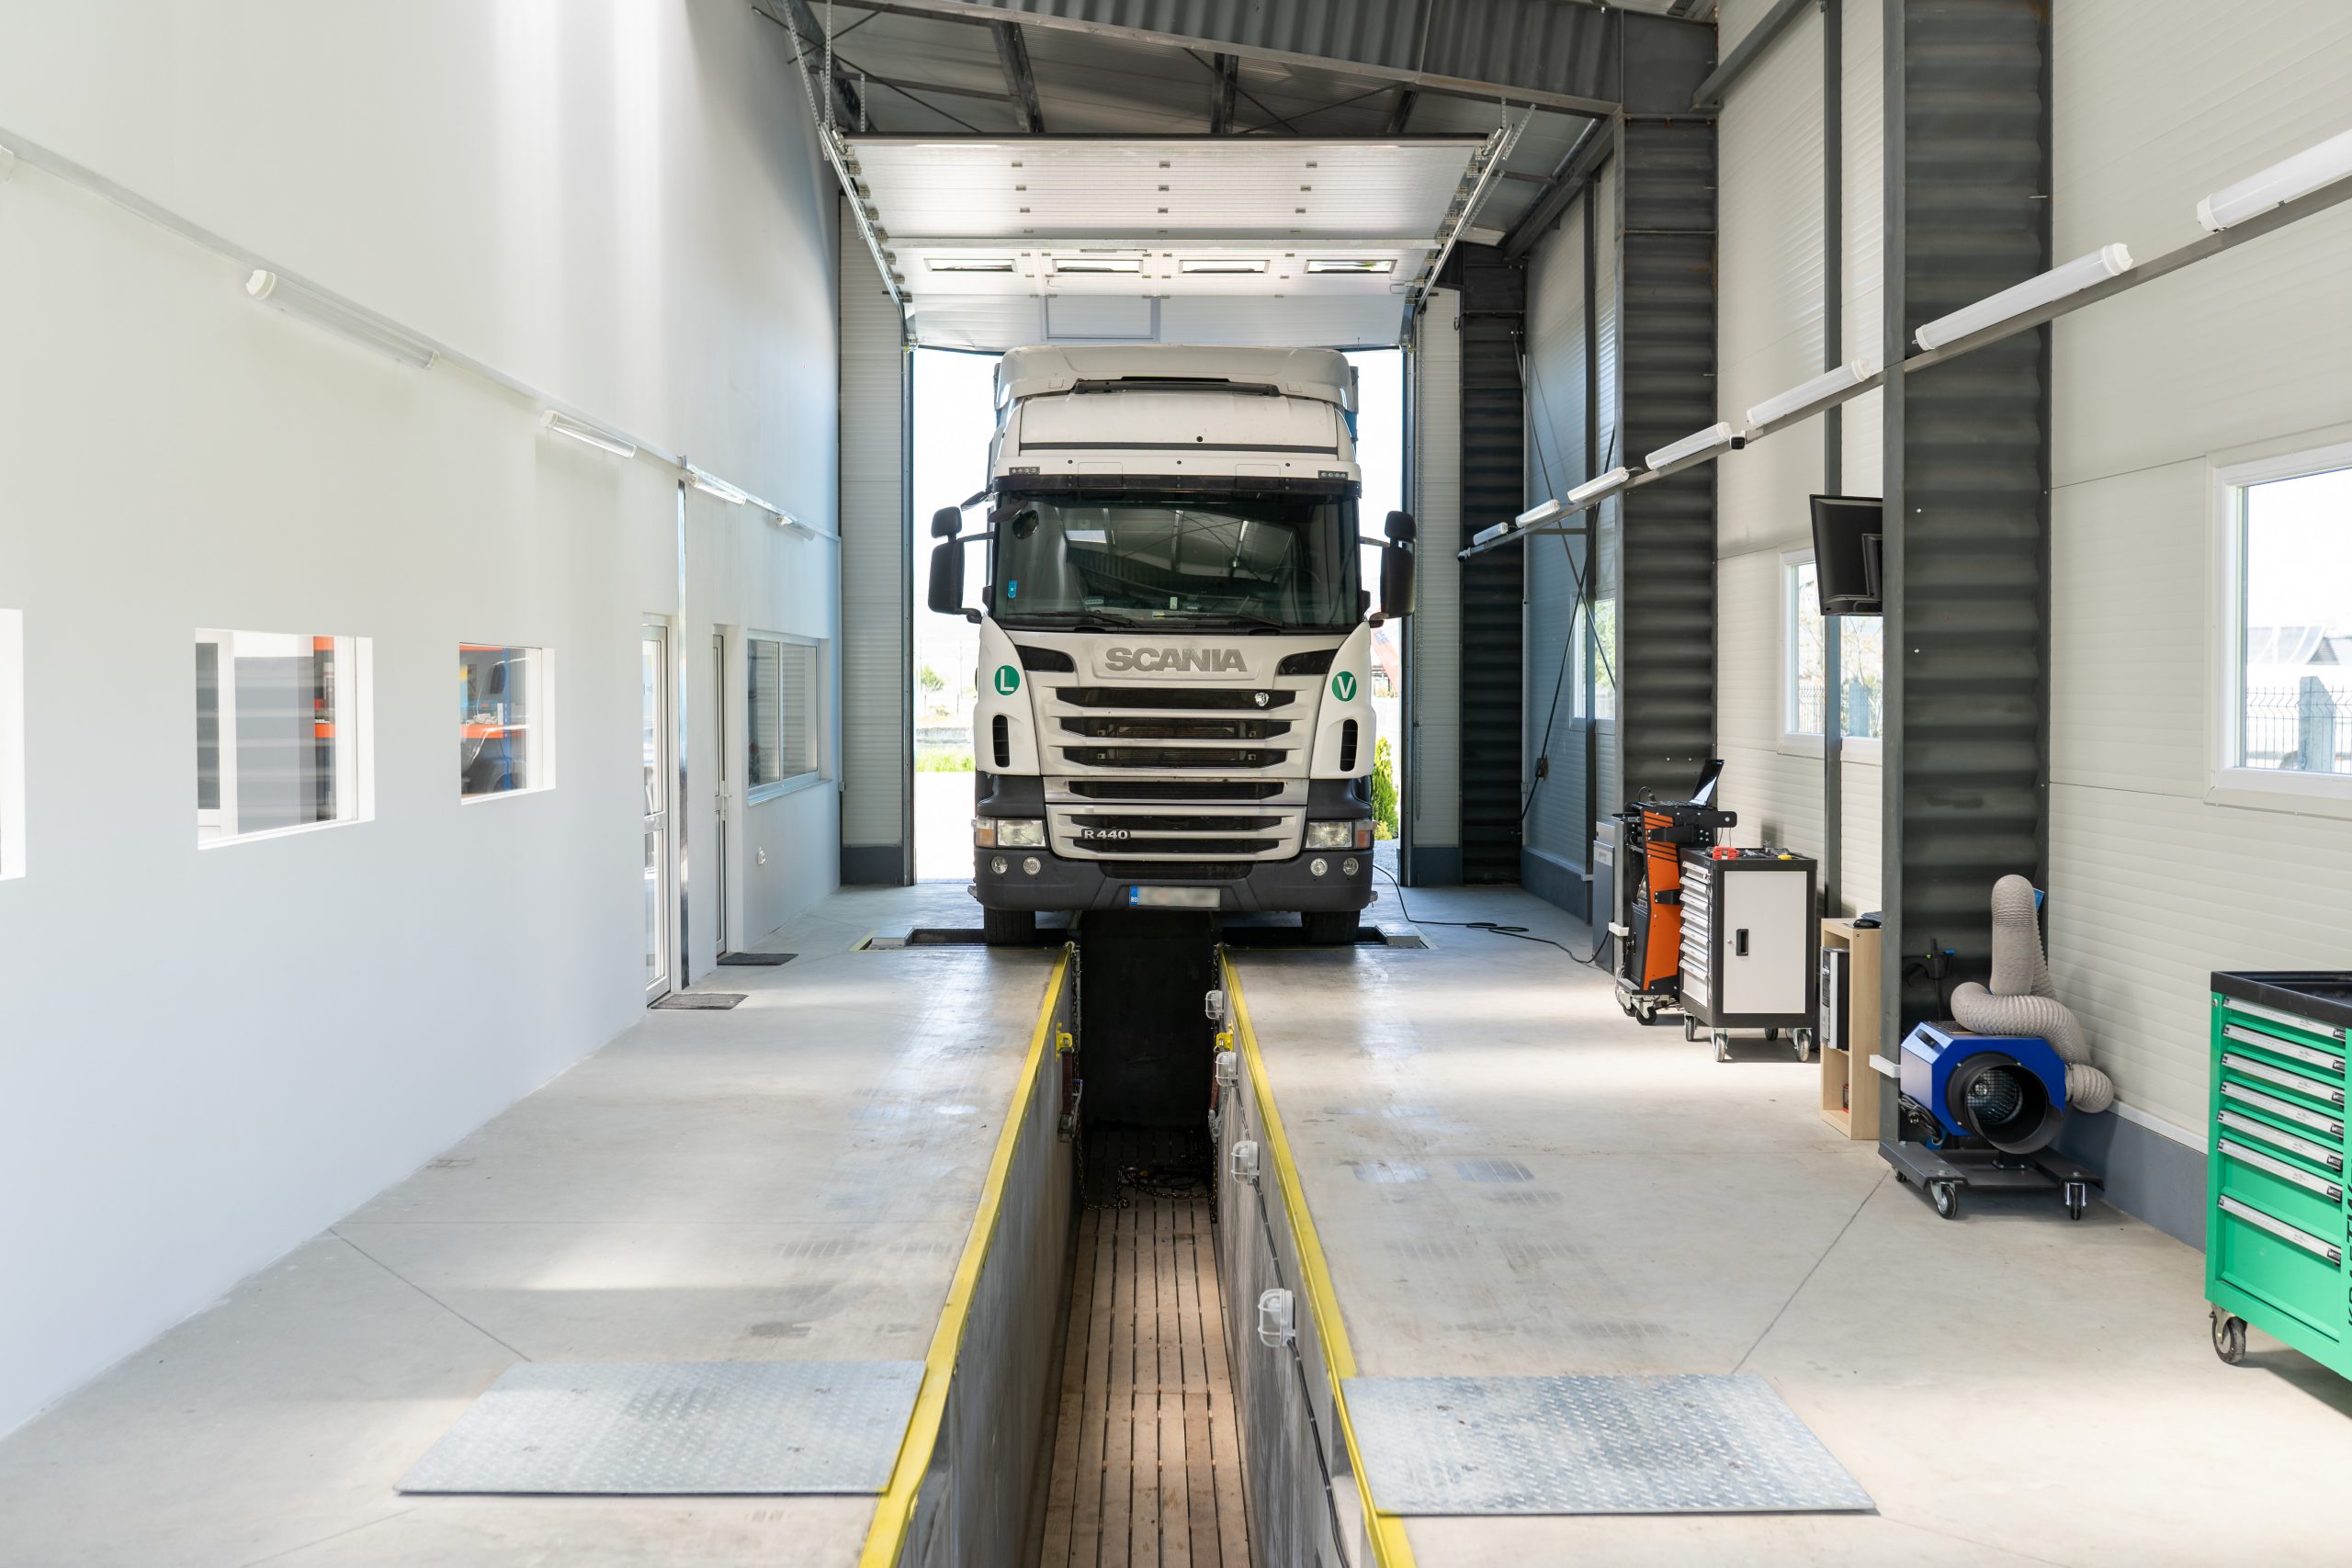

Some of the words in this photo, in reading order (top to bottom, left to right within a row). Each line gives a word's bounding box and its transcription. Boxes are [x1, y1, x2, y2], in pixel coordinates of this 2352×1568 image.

[1105, 647, 1248, 672] SCANIA
[1001, 668, 1014, 691] L
[1337, 675, 1353, 699] V
[1084, 829, 1094, 840] R
[1096, 829, 1128, 840] 440
